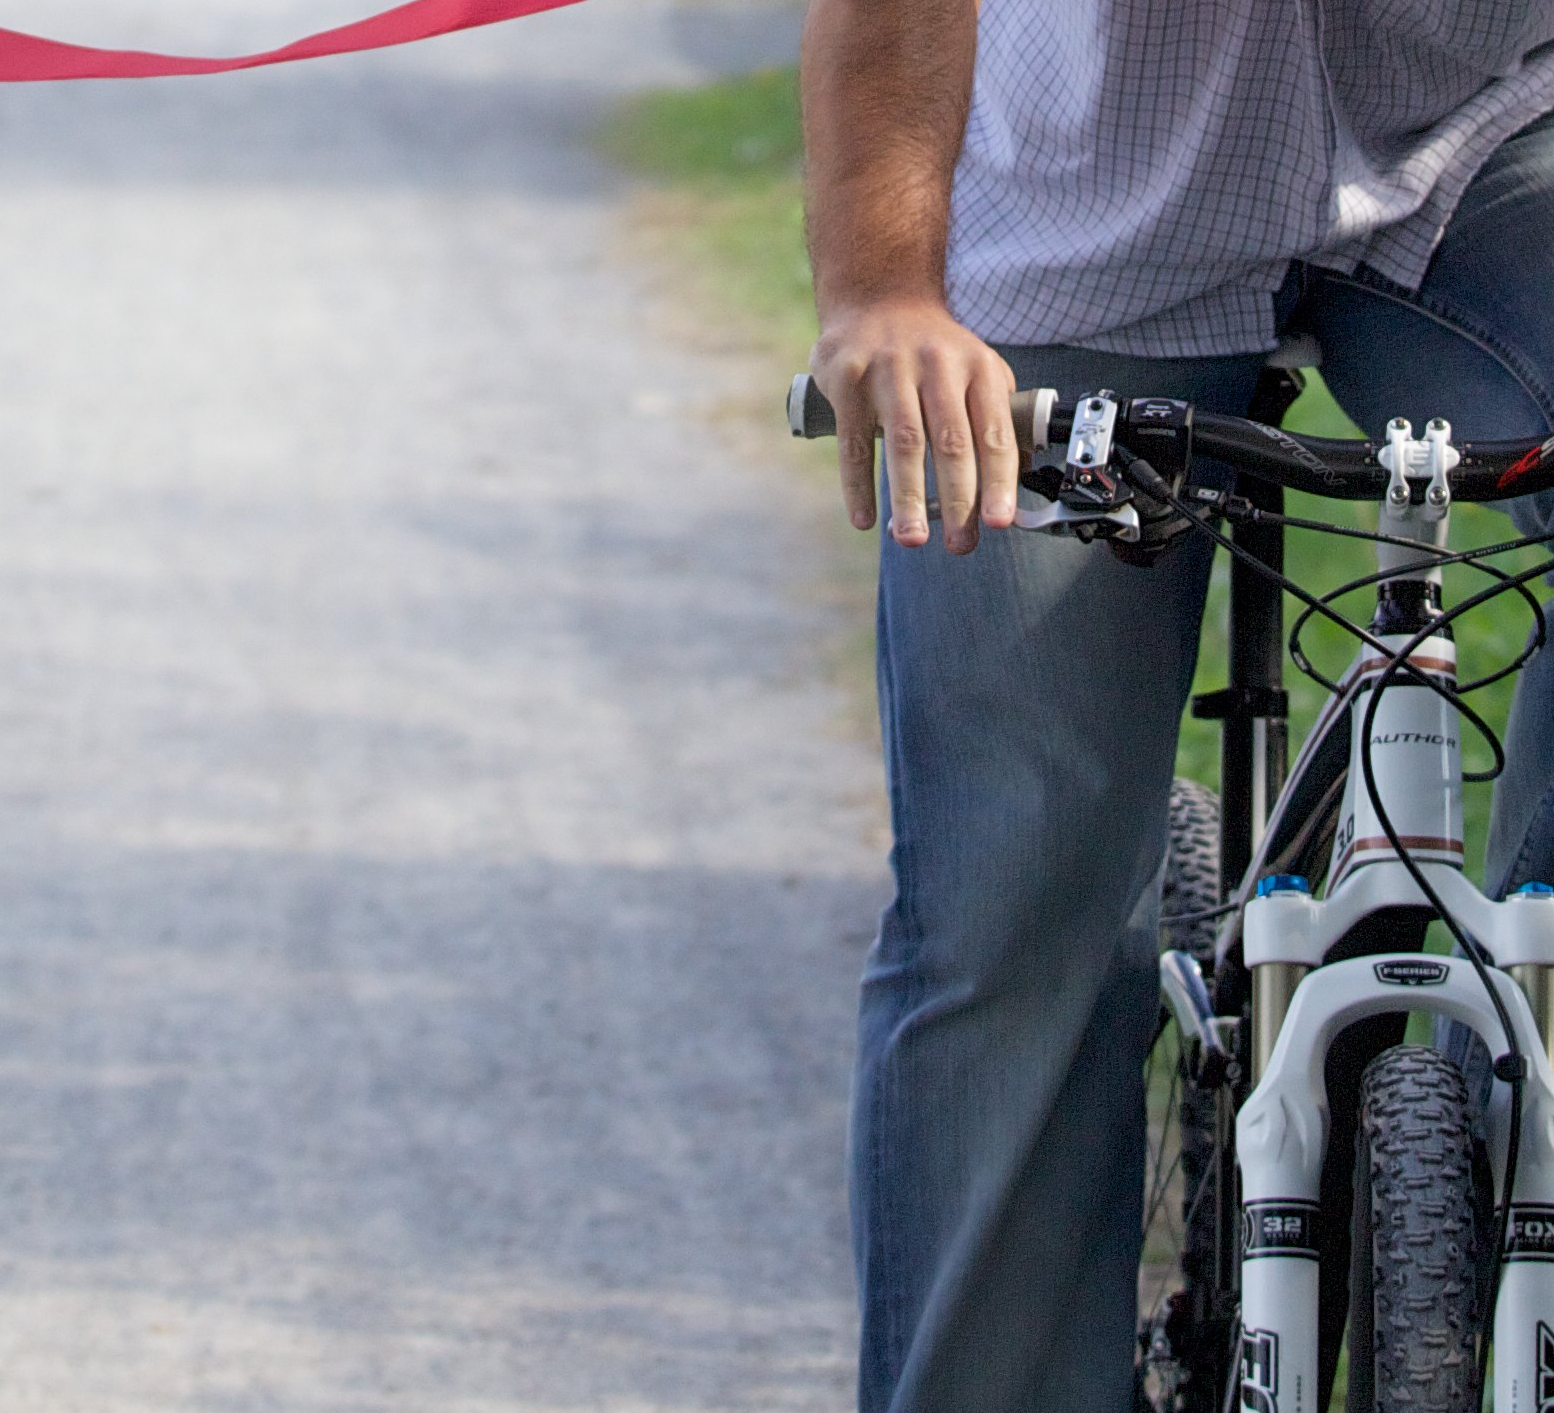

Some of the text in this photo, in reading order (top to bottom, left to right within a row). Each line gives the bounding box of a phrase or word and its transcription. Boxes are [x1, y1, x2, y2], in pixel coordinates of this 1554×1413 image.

[1370, 732, 1456, 748] AUTHOR
[1337, 812, 1355, 861] 3.0
[1262, 1216, 1302, 1233] 32
